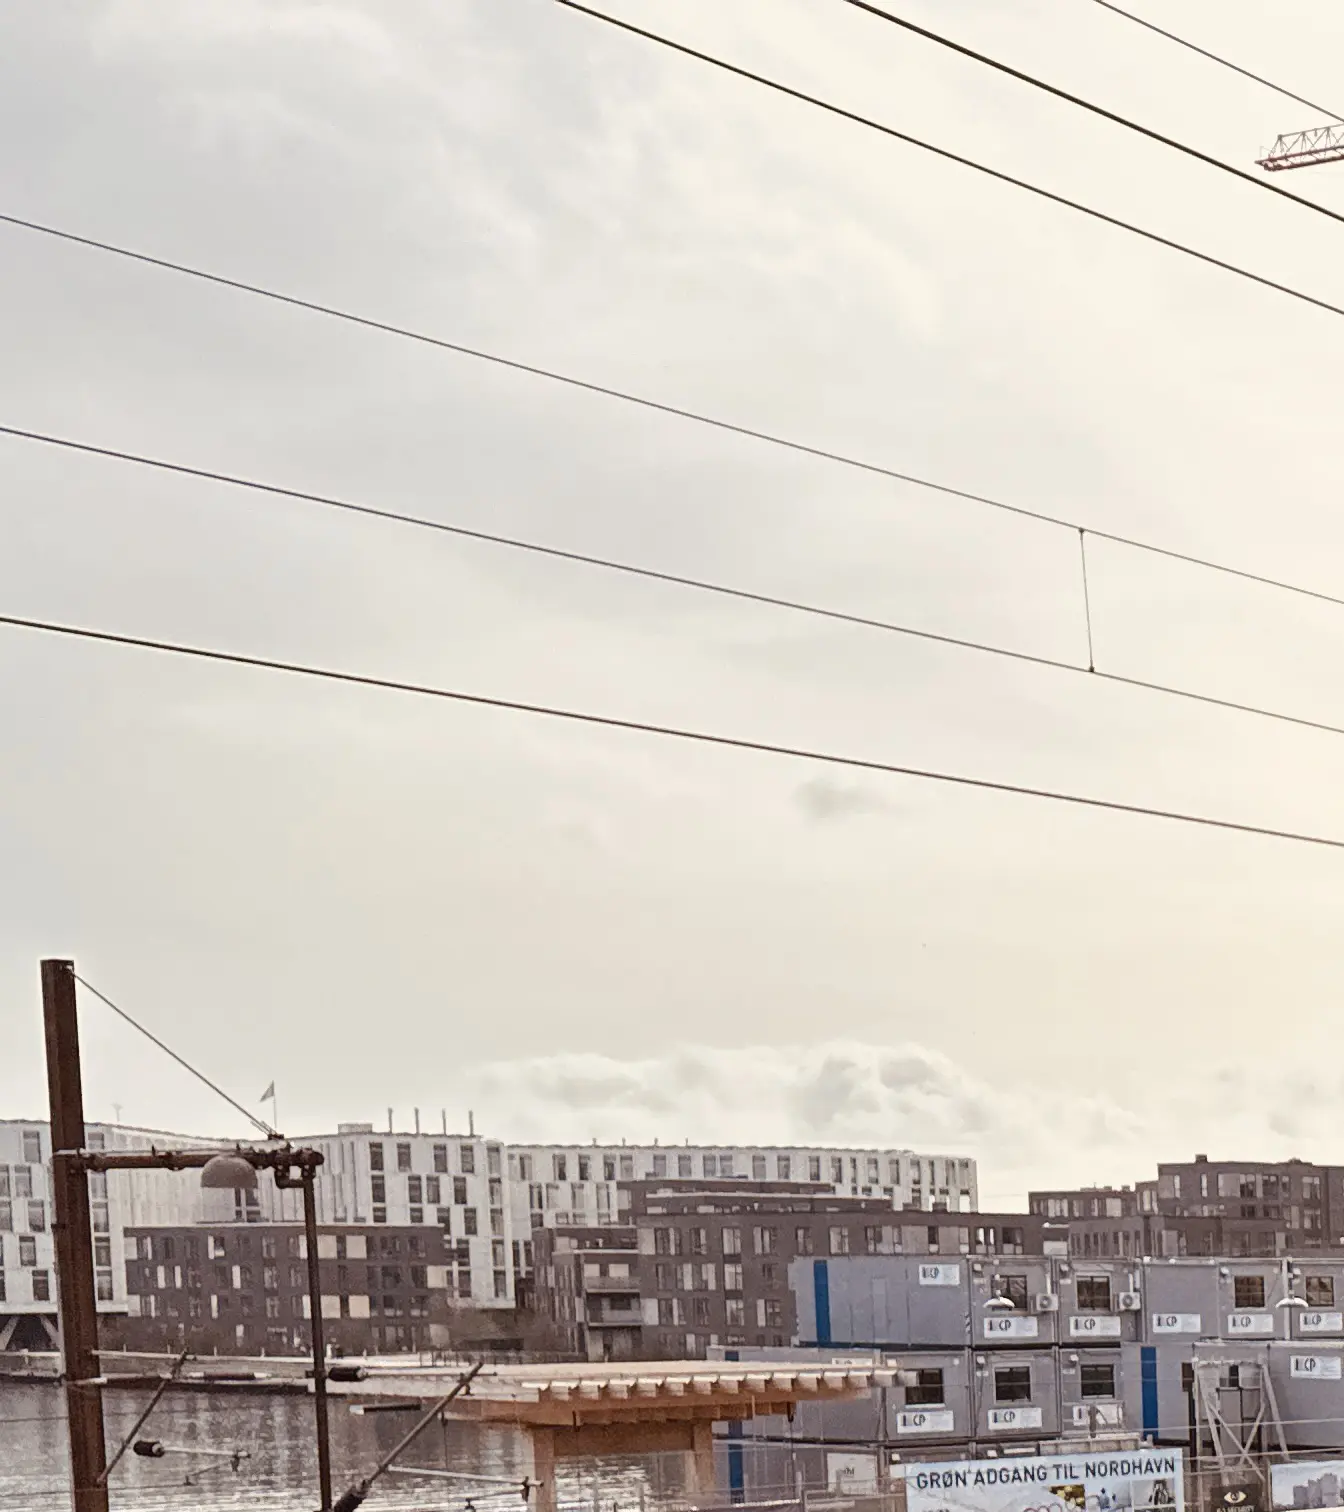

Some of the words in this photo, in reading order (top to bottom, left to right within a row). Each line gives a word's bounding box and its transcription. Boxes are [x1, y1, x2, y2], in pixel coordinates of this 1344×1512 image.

[916, 1471, 968, 1489] GRØN
[974, 1464, 1048, 1485] ADGANG
[1052, 1463, 1079, 1480] TIL
[1085, 1457, 1175, 1478] NORDHAVN
